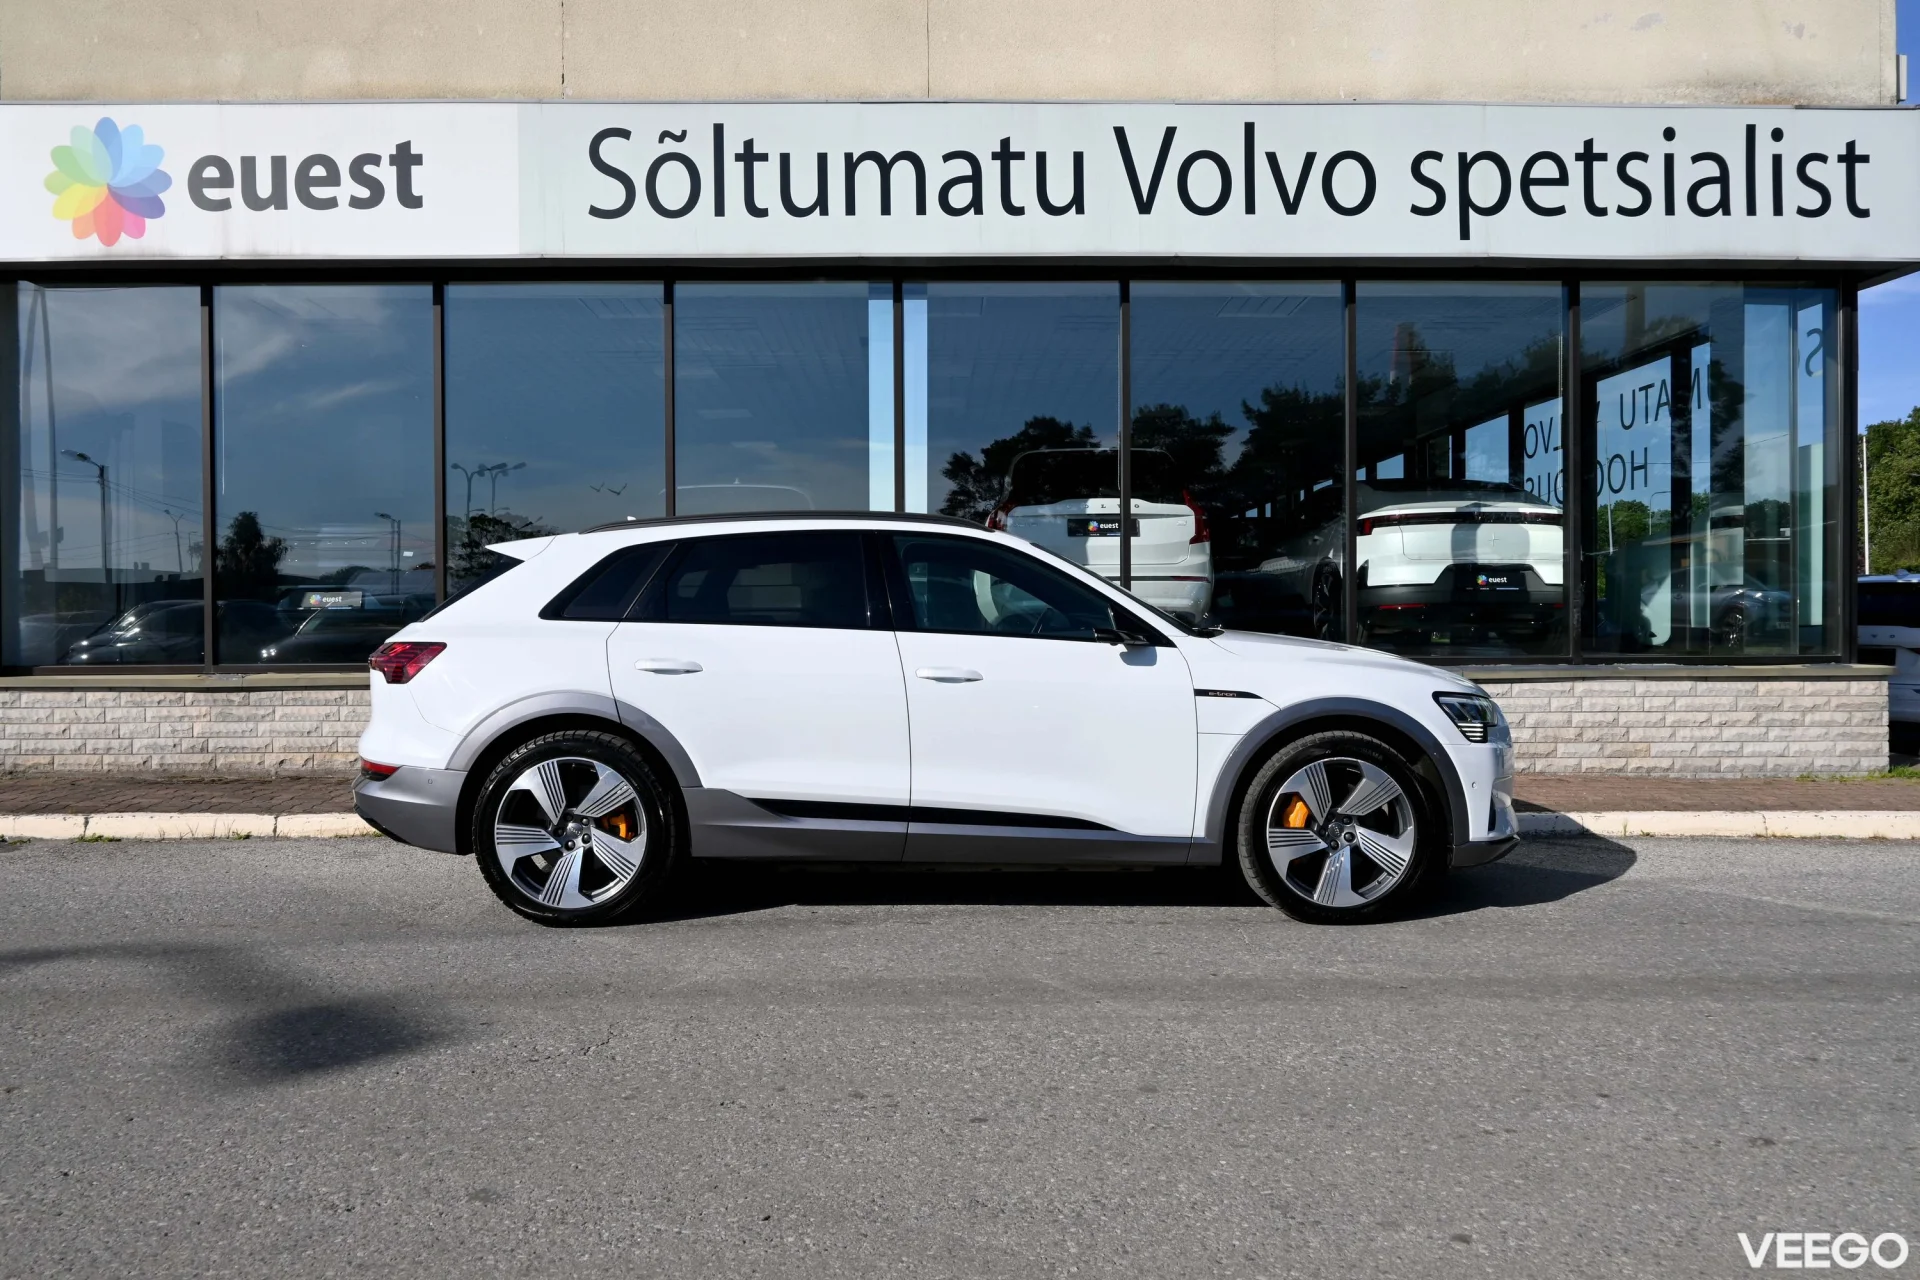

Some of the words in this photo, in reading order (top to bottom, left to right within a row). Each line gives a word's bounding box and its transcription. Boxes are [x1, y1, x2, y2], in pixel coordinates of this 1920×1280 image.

[187, 140, 424, 212] euest
[587, 122, 1086, 220] Sõltumatu
[1112, 121, 1377, 217] Volvo
[1409, 124, 1872, 240] spetsialist
